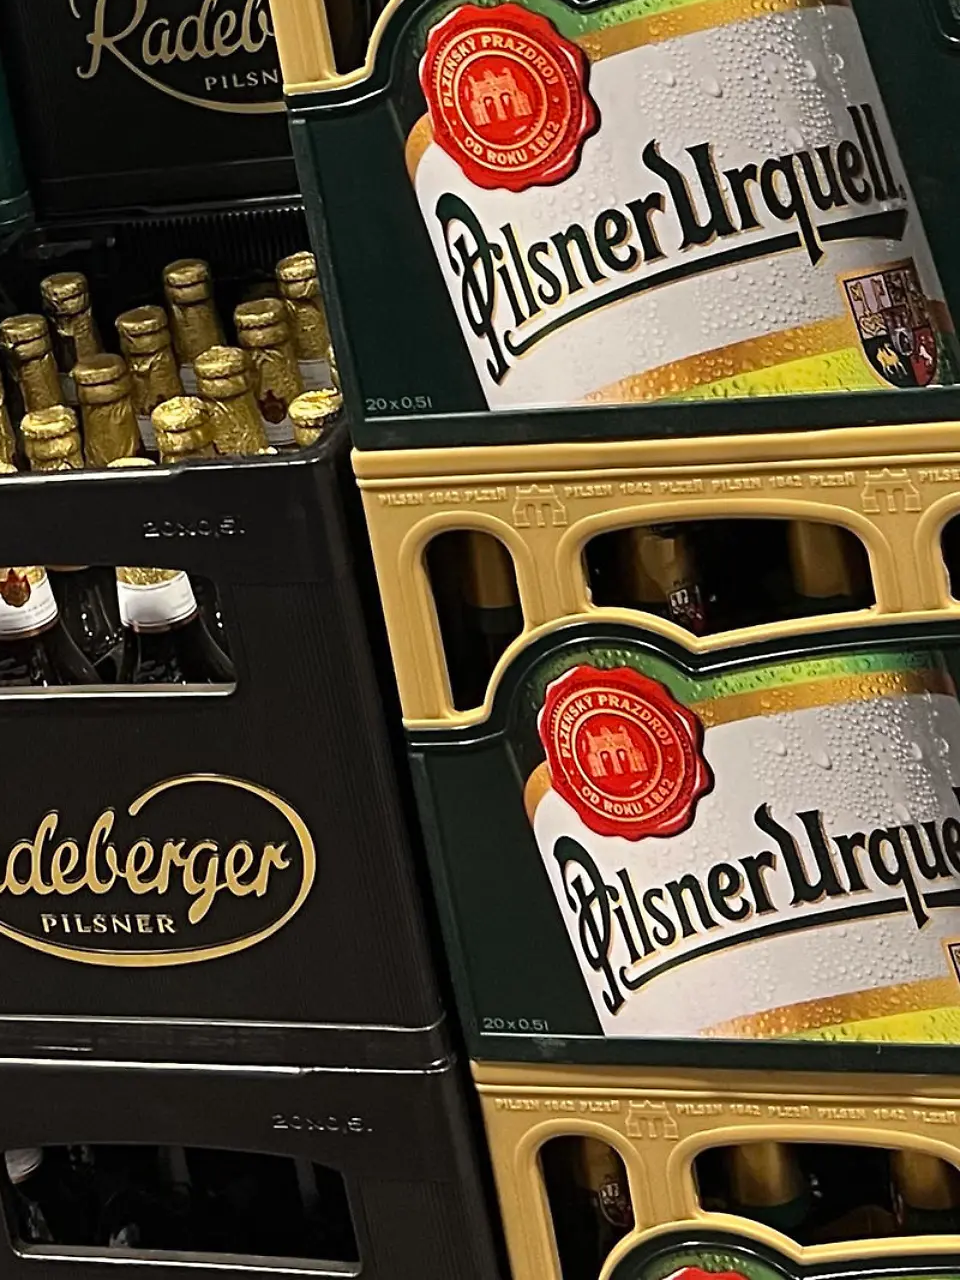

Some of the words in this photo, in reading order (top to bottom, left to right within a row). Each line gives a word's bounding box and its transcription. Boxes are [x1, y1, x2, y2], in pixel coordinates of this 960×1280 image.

[205, 68, 278, 91] PILSN
[480, 34, 559, 85] PRAZDROJ
[464, 136, 484, 156] OD
[487, 149, 528, 165] ROKU
[529, 120, 560, 156] 1842
[436, 191, 667, 385] Pilsner
[365, 398, 387, 411] 20
[390, 400, 400, 410] x
[597, 693, 674, 747] PRAZDROJ
[581, 785, 600, 804] OD
[603, 799, 644, 816] ROKU
[644, 777, 675, 808] 1842
[553, 835, 778, 1016] Pilsner
[754, 786, 960, 930] Urque
[41, 912, 178, 934] PILSNER
[483, 1017, 504, 1030] 20
[507, 1020, 517, 1030] x
